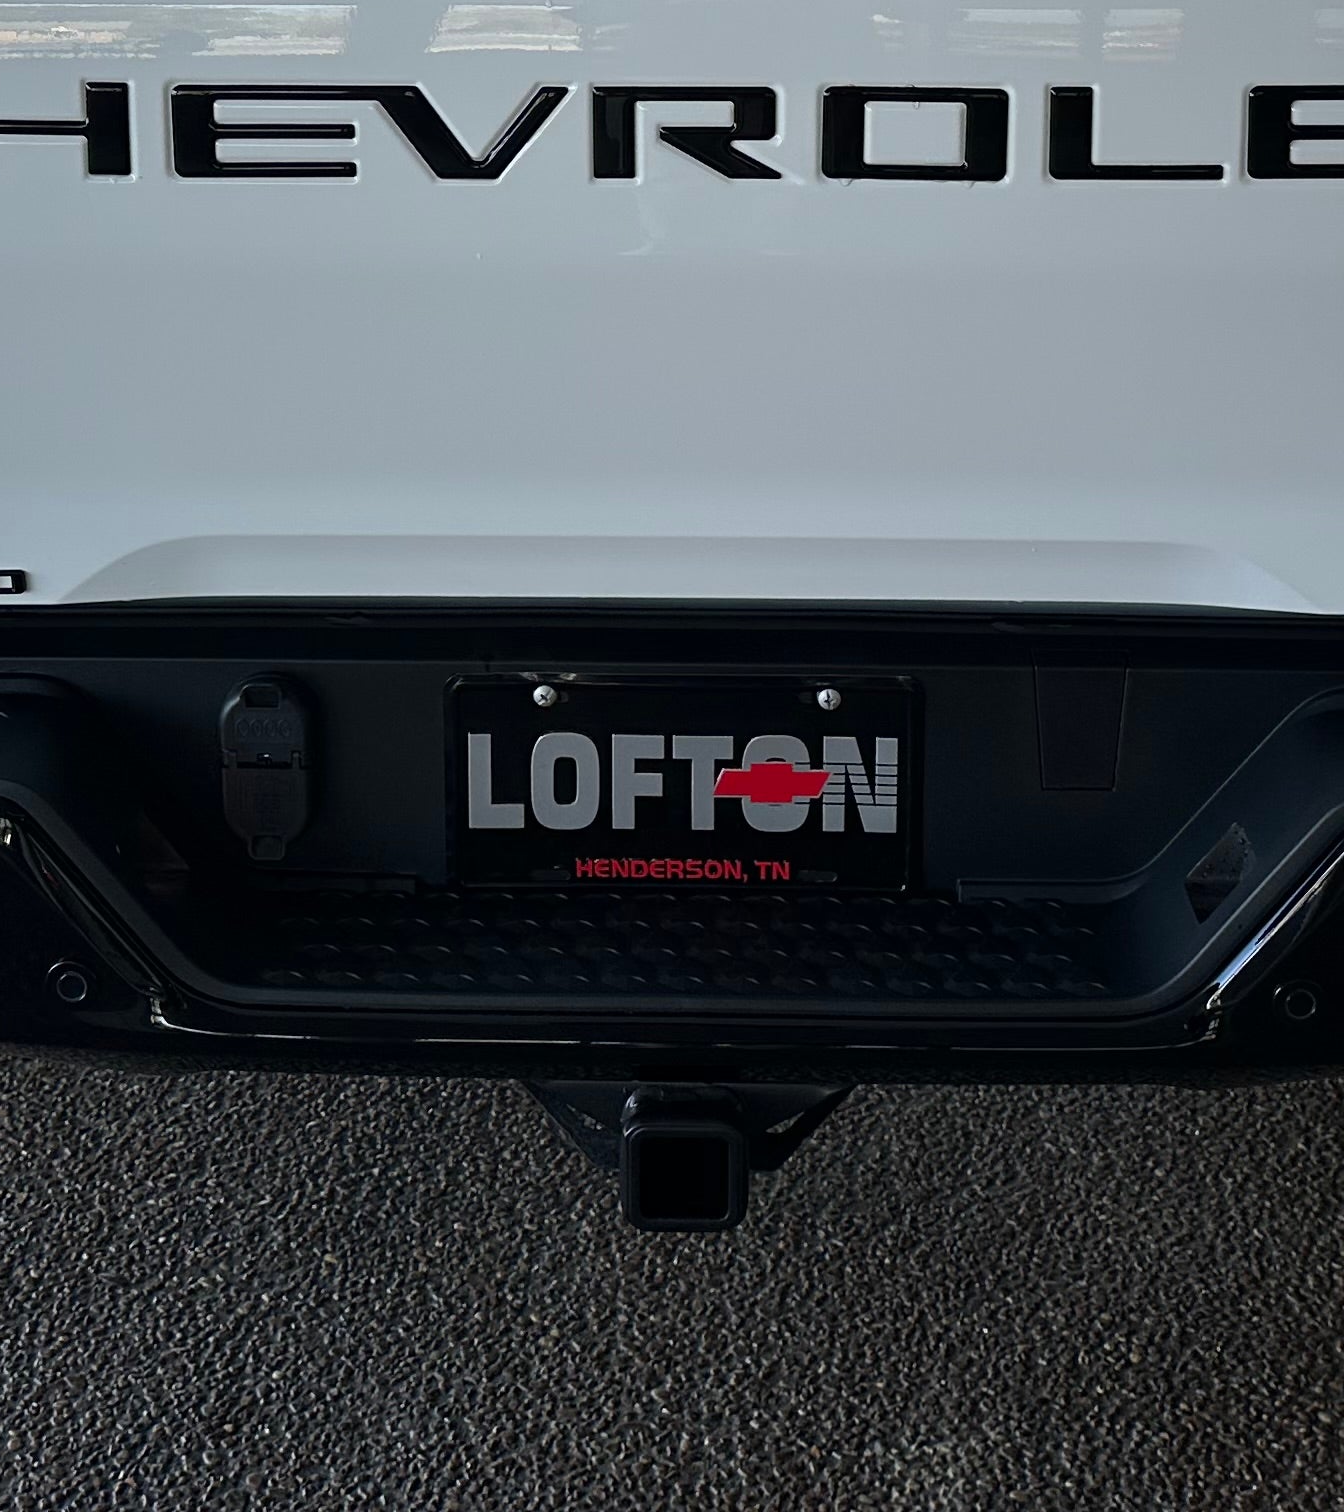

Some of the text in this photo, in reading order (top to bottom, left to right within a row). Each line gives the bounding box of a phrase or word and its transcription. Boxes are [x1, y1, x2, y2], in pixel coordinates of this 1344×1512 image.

[467, 731, 899, 834] LOFTON
[575, 857, 791, 884] HENDERSON, TN
